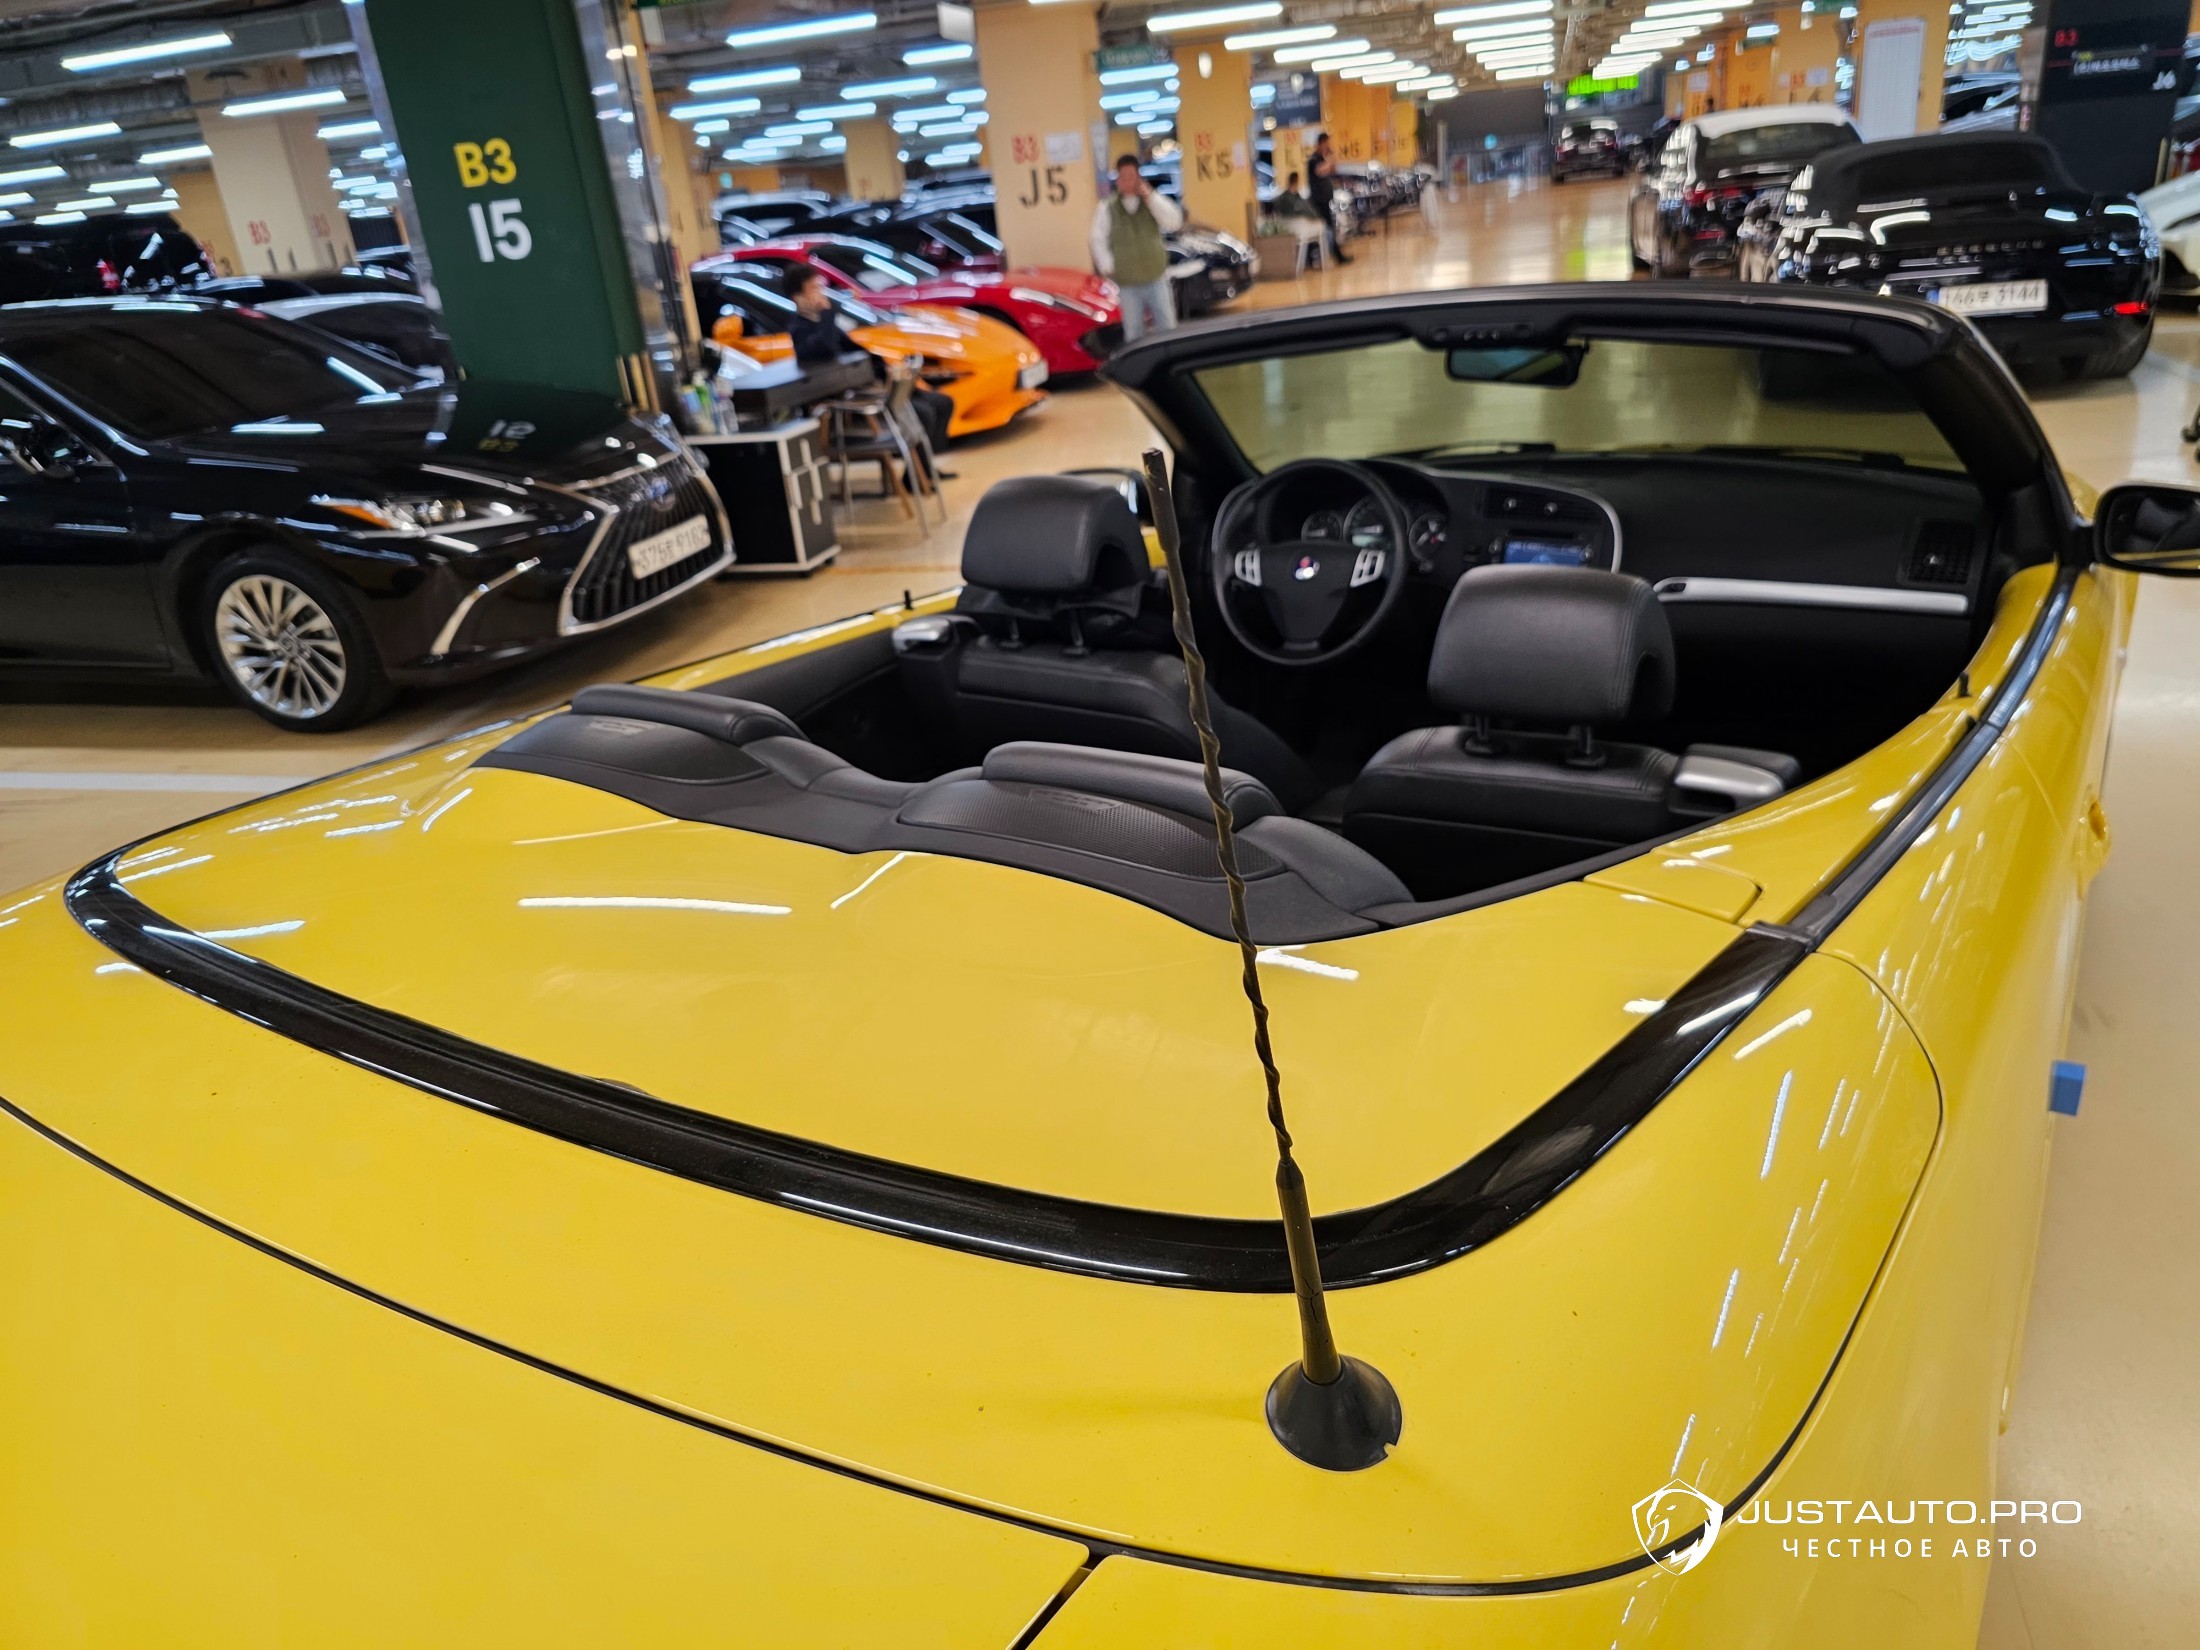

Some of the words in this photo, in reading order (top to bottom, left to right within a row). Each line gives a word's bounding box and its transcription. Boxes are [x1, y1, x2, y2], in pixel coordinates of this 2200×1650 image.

[453, 137, 517, 188] B3
[1196, 150, 1232, 182] K5
[1018, 165, 1068, 209] J5
